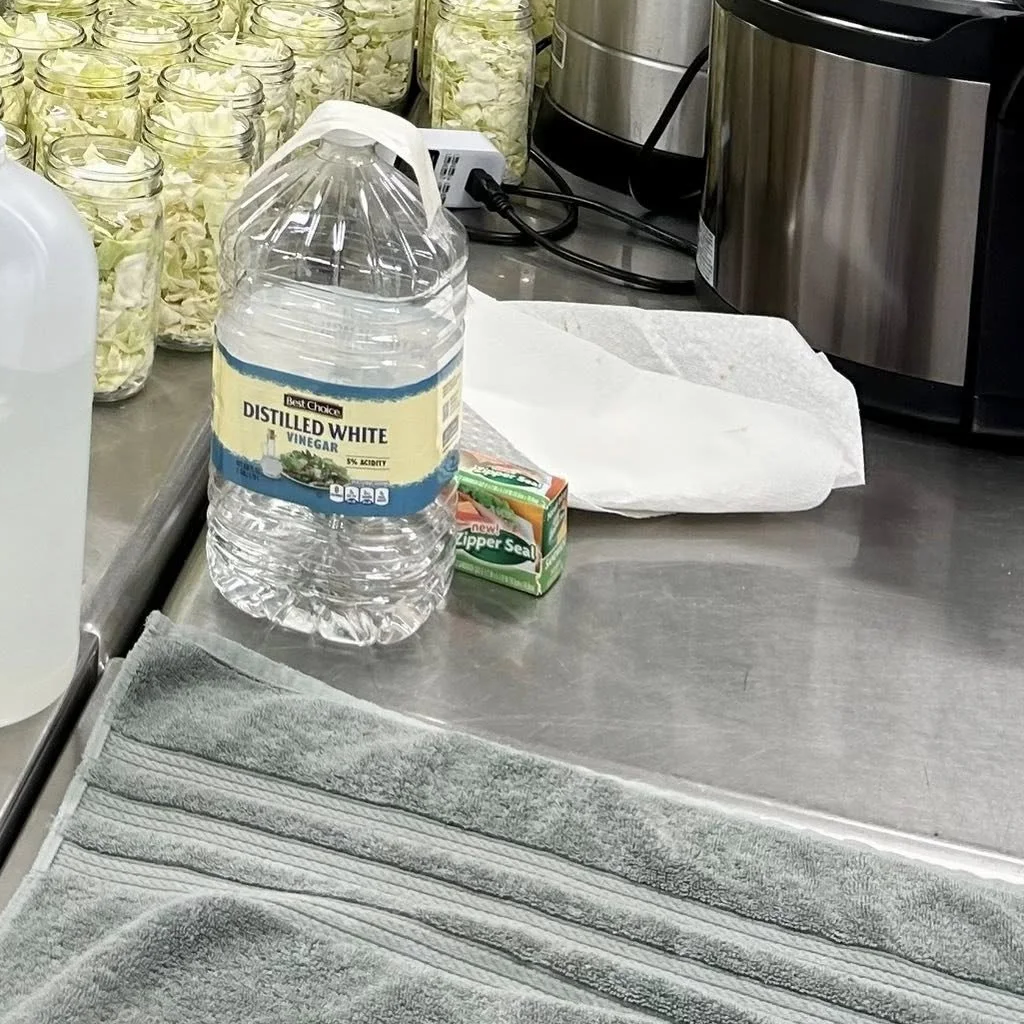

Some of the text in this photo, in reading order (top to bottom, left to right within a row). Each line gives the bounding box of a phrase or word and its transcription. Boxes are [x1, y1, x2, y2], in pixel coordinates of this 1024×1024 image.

[285, 396, 342, 417] Best Choice
[243, 401, 388, 445] DISTILLED WHITE
[287, 432, 339, 453] VINEGAR
[360, 459, 387, 467] ACIDITY
[470, 523, 501, 536] new!
[505, 537, 536, 563] Seal
